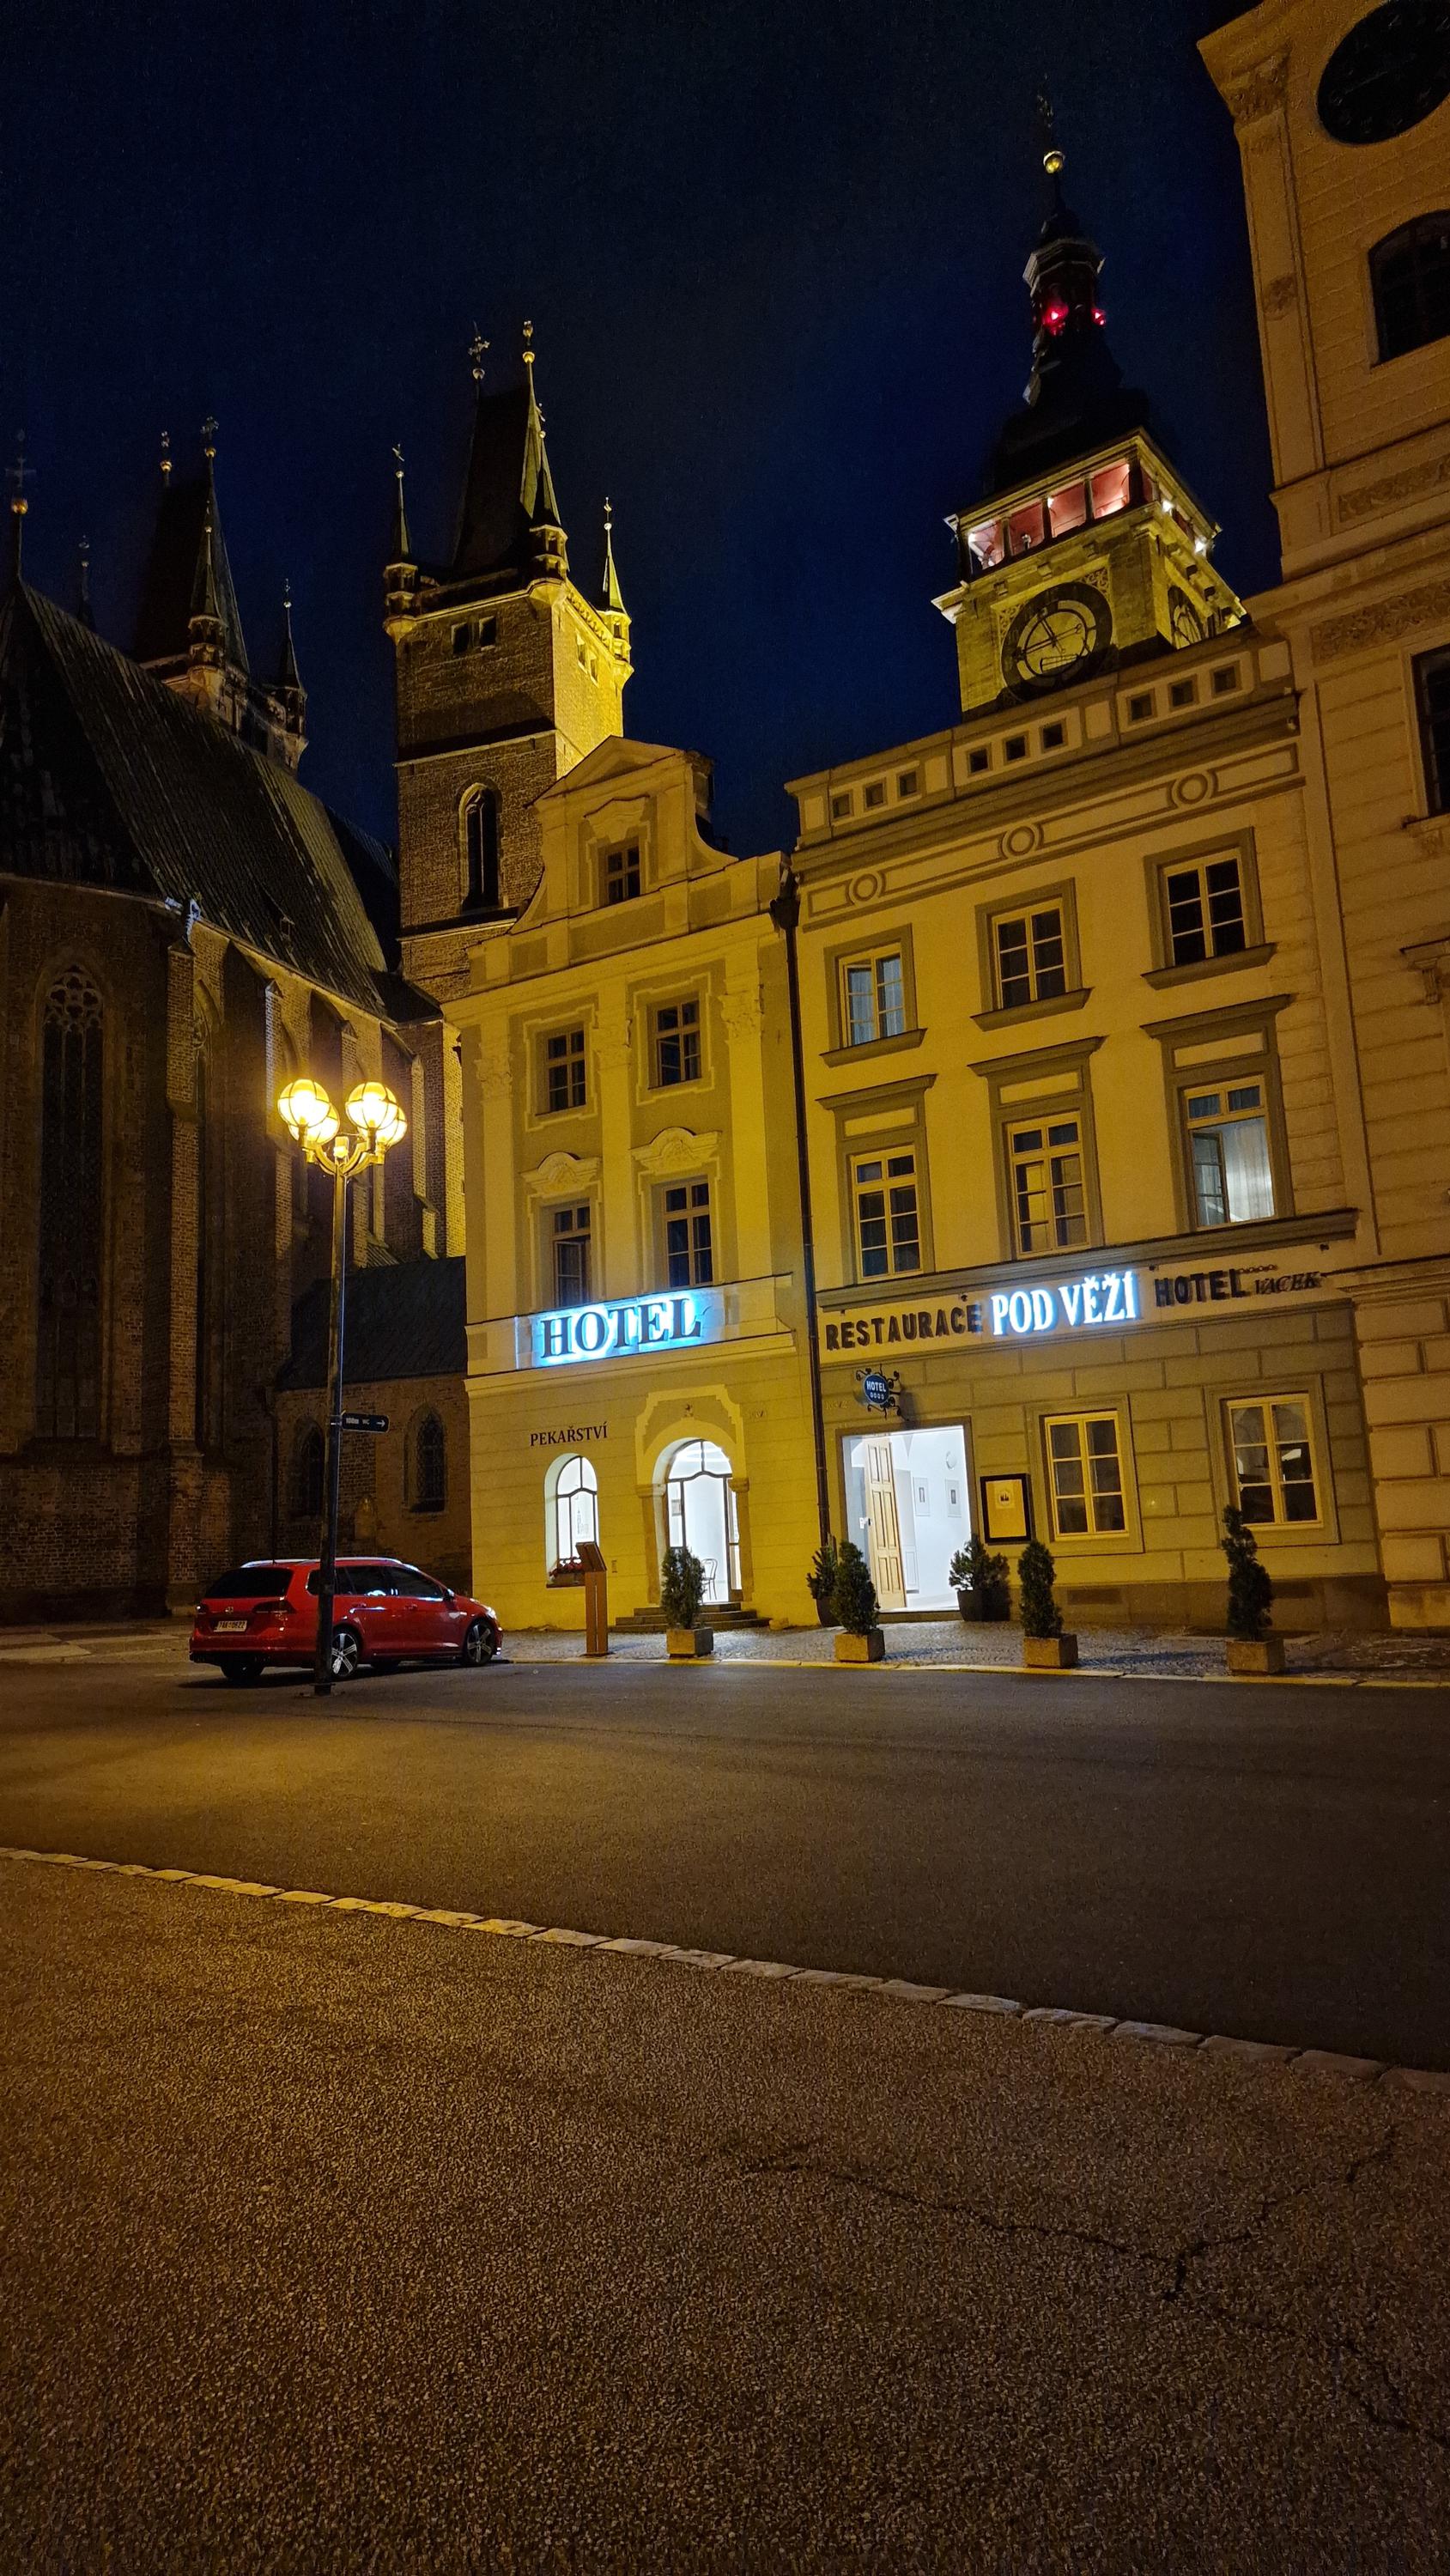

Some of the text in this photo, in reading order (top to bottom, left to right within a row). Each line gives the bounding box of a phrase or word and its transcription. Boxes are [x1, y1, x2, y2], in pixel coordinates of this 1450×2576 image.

[1154, 1268, 1248, 1308] HOTEL
[540, 1297, 701, 1358] HOTEL
[826, 1271, 1136, 1351] RESTAURACE POD VĚŽÍ
[866, 1380, 887, 1393] HOTEL
[530, 1421, 608, 1447] PEKAŘSTVÍ
